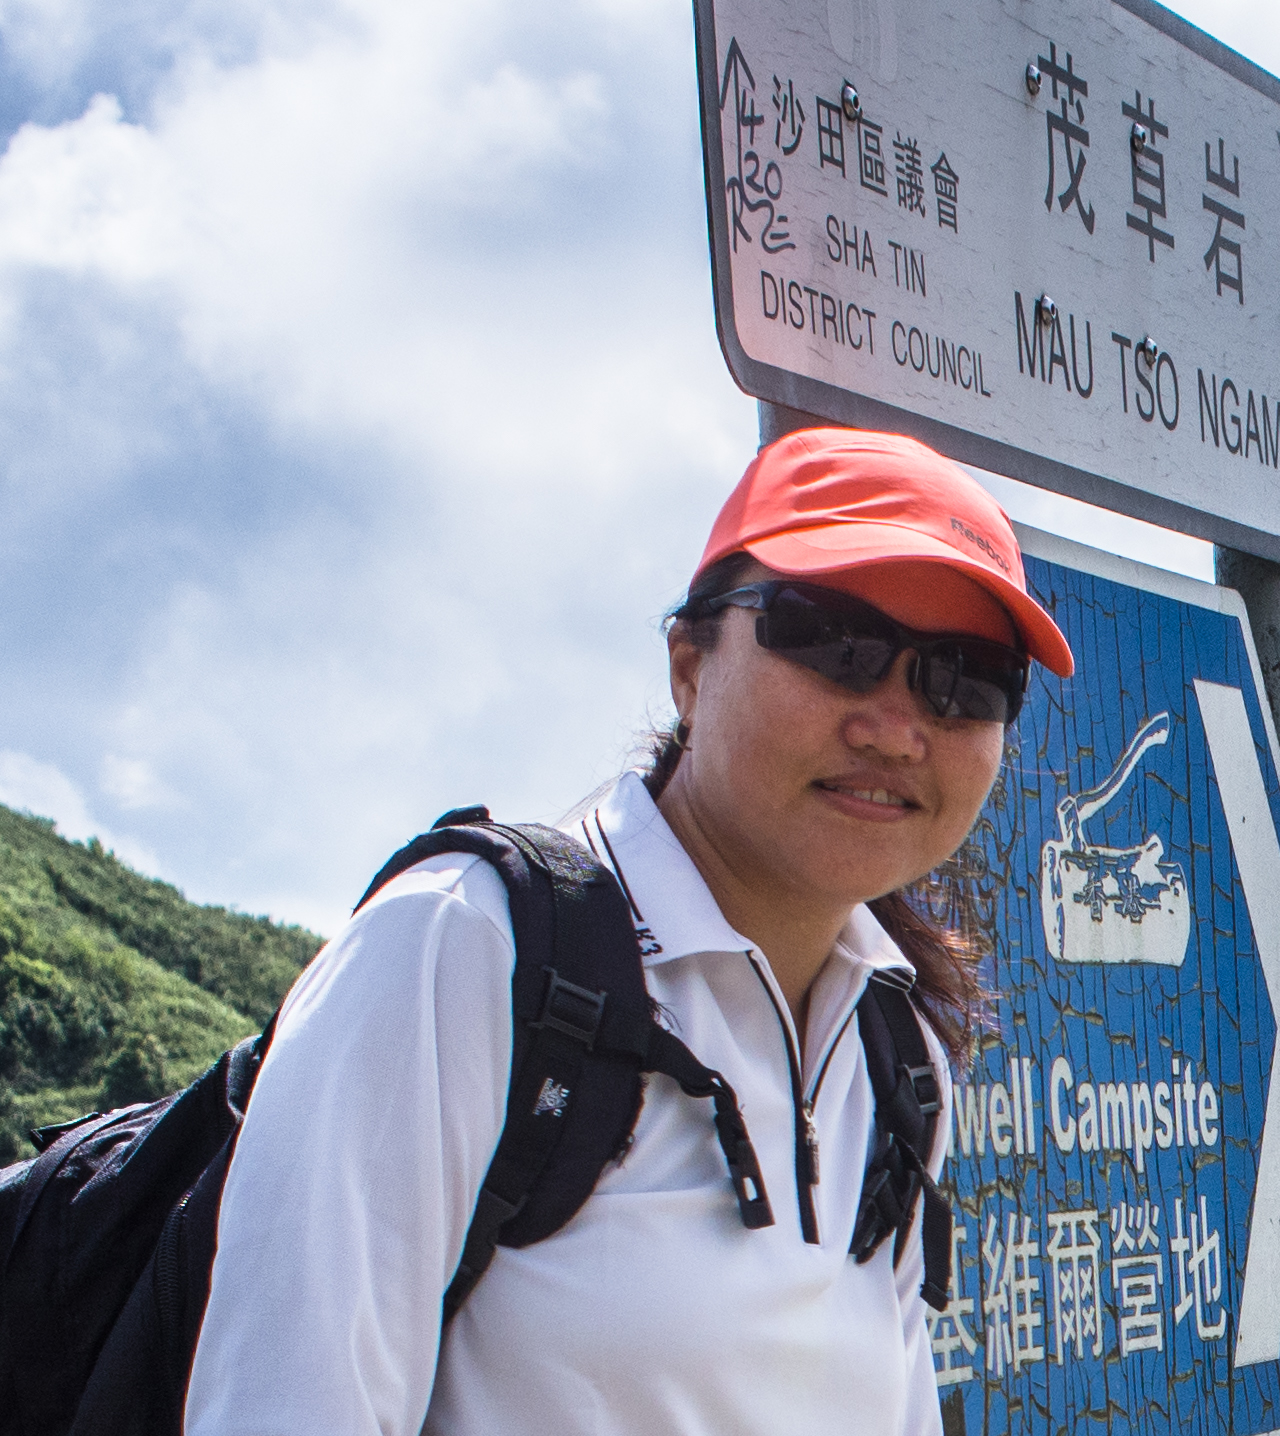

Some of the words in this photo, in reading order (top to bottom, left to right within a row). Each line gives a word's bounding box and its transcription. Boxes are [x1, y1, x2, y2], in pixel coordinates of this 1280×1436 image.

[771, 73, 960, 235] 沙田區議會
[1038, 40, 1246, 307] 茂草岩
[826, 214, 877, 278] SHA
[888, 239, 927, 298] TIN
[760, 269, 877, 356] DISTRICT
[891, 319, 992, 398] COUNCIL
[1014, 290, 1095, 400] MAU
[1111, 331, 1180, 432] TSO
[947, 1056, 1036, 1159] well
[1049, 1055, 1221, 1173] Campsite
